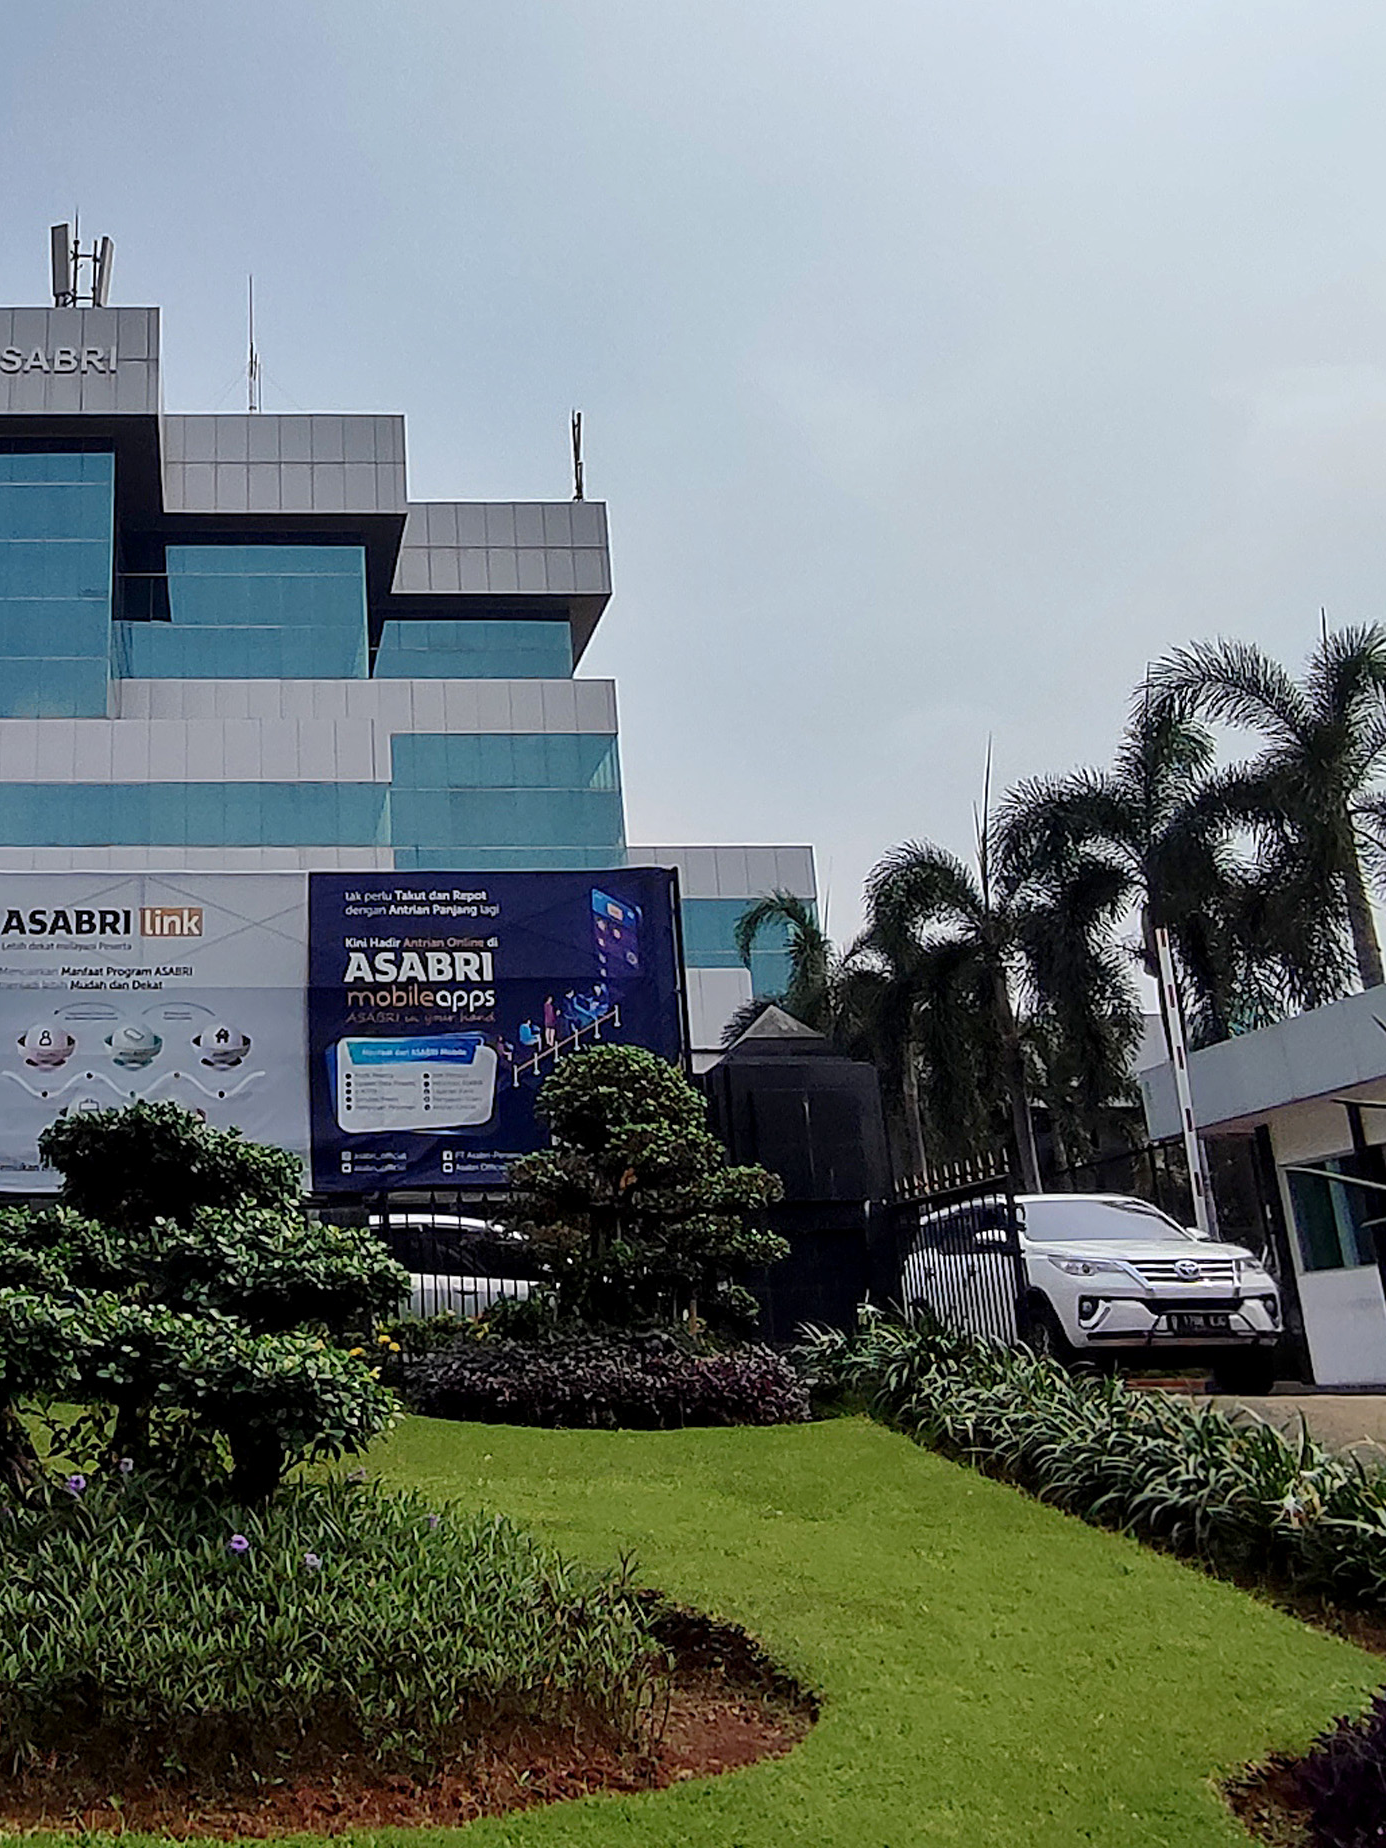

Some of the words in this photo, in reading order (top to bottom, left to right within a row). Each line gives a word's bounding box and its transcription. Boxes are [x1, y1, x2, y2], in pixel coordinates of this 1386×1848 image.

[394, 890, 427, 901] Takut
[429, 890, 450, 901] dan
[452, 890, 487, 903] Repot
[388, 904, 430, 915] Antrian
[432, 904, 478, 917] Panjang
[1, 908, 132, 936] ASABRI
[145, 908, 201, 936] link
[345, 937, 368, 948] Kini
[370, 937, 401, 948] Hadir
[403, 937, 445, 948] Antrian
[446, 937, 484, 948] Online
[486, 937, 499, 948] di
[61, 966, 104, 976] Manfaat
[106, 967, 152, 978] Program
[154, 967, 193, 976] ASABRI
[343, 951, 494, 983] ASABRI
[70, 980, 107, 990] Mudah
[109, 980, 130, 990] dan
[132, 980, 163, 990] Dekat
[347, 983, 495, 1013] mobileapps
[345, 1011, 401, 1024] ASABRI
